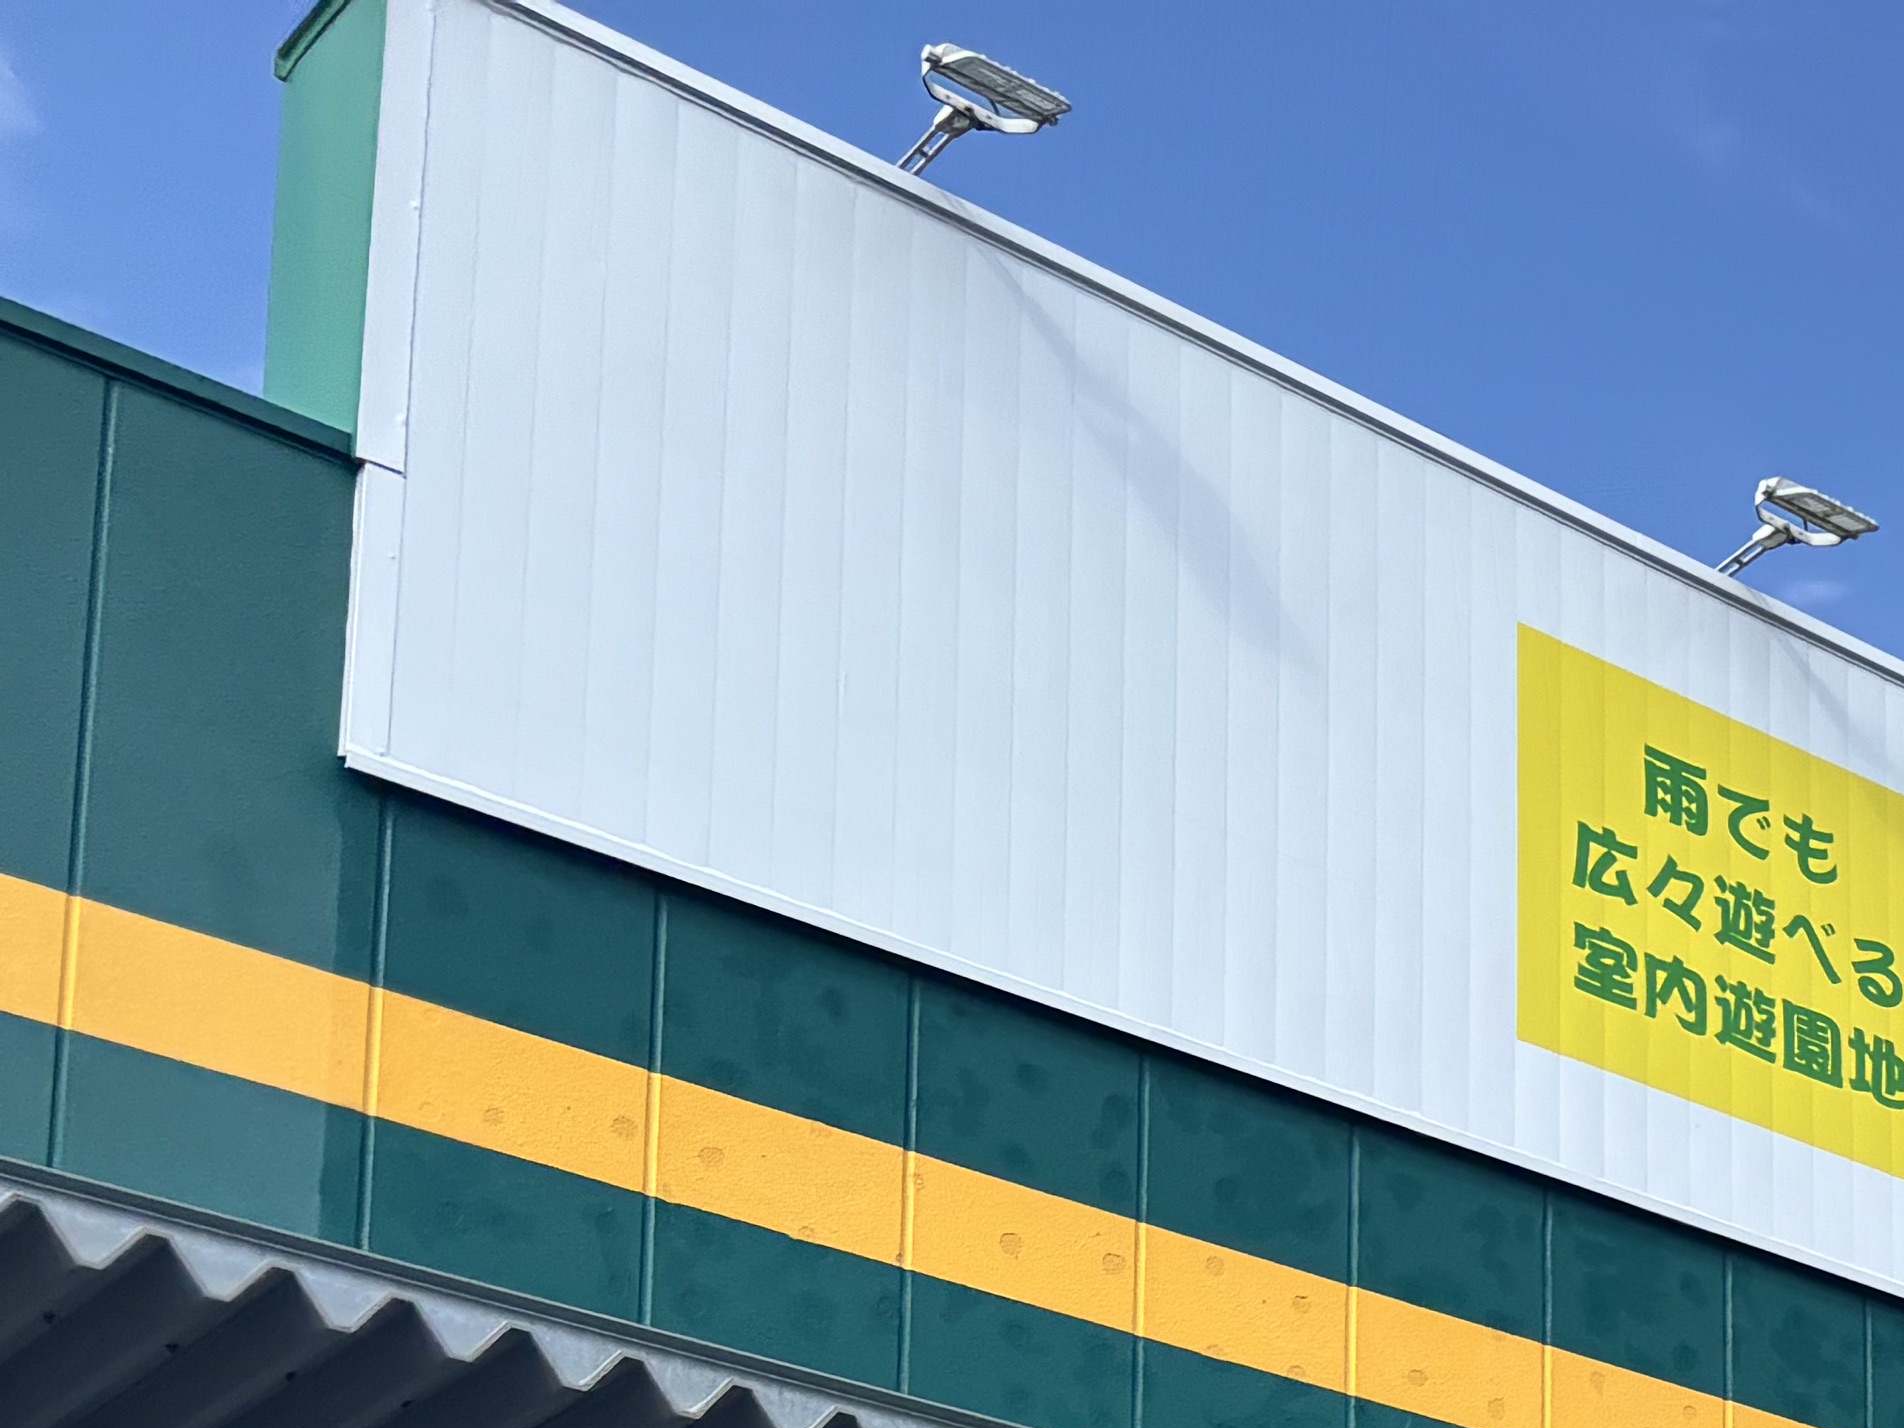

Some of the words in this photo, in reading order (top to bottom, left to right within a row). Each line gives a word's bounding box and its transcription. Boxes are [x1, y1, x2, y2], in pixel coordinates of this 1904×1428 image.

[1644, 743, 1839, 887] 雨でも
[1573, 820, 1904, 1009] 広々遊べる
